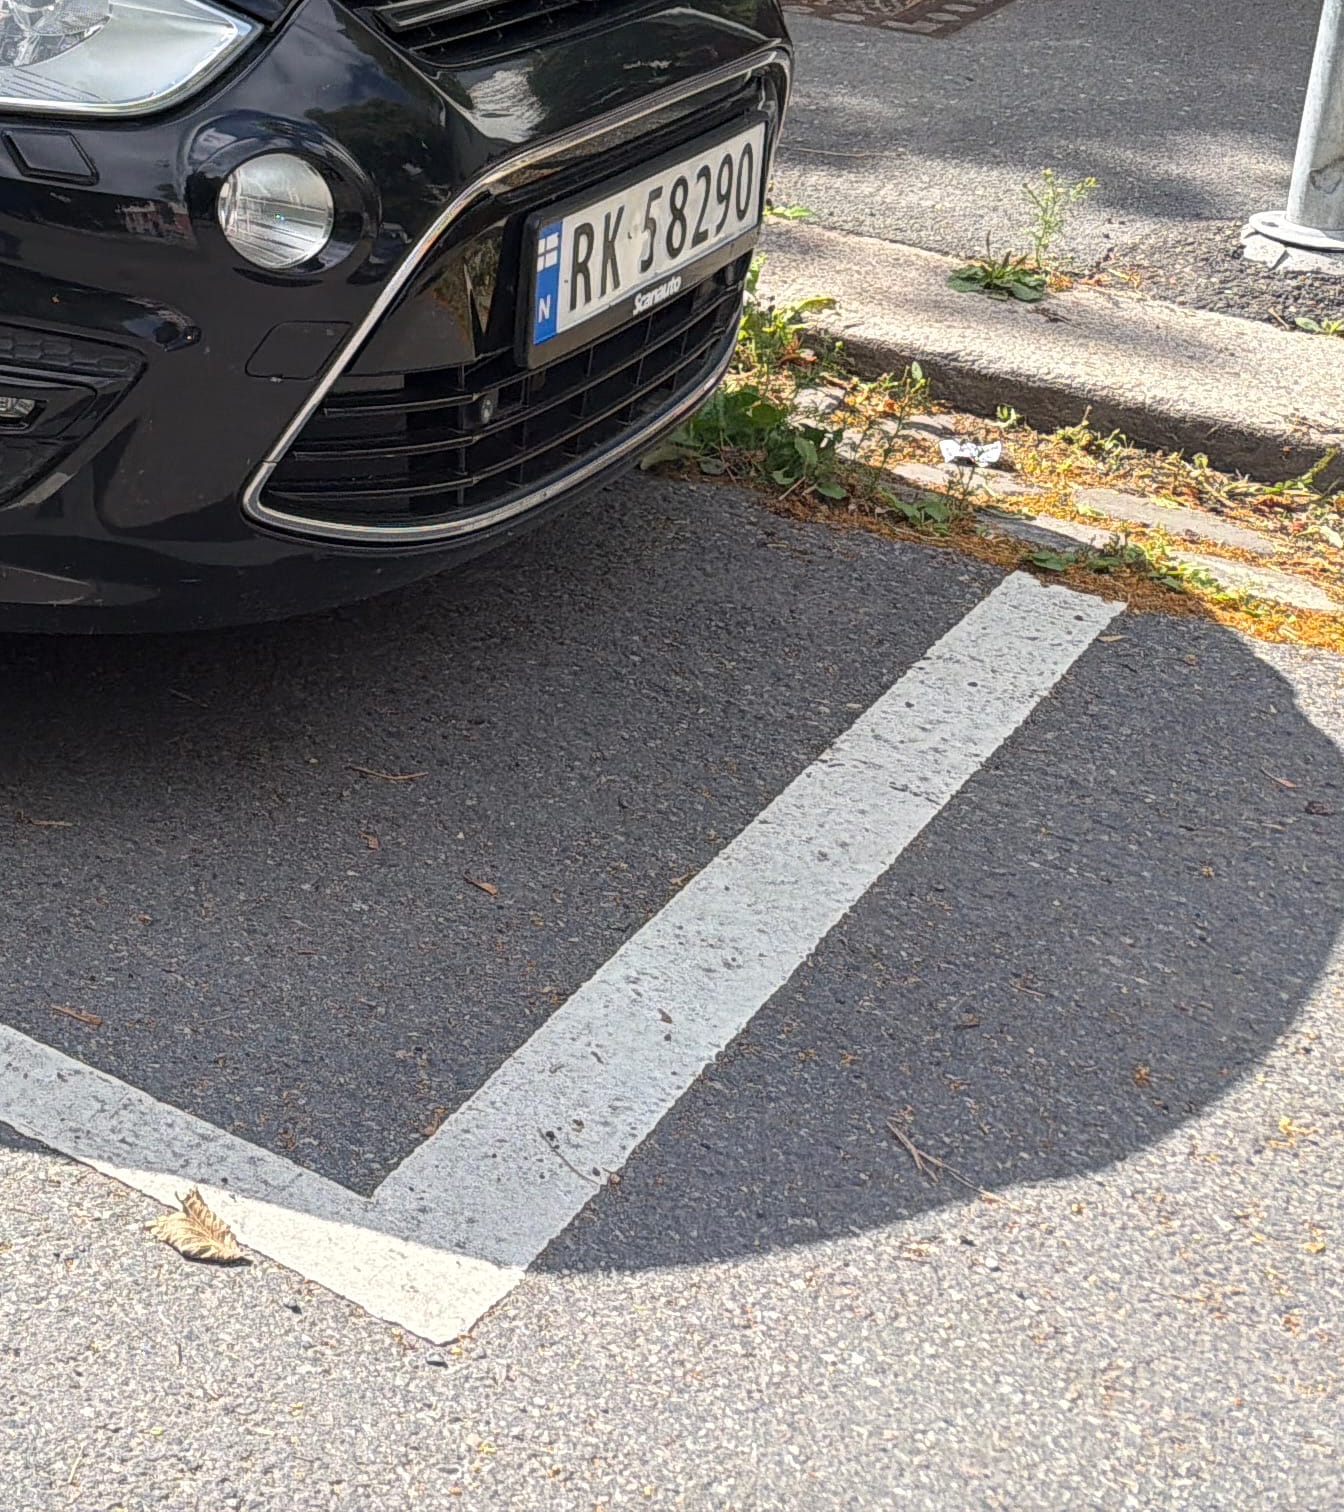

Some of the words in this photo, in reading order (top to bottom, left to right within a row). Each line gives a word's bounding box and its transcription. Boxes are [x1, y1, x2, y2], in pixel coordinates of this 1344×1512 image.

[569, 205, 625, 312] RK
[639, 142, 754, 274] 58290
[538, 295, 551, 323] N
[632, 275, 682, 316] Scanauto
